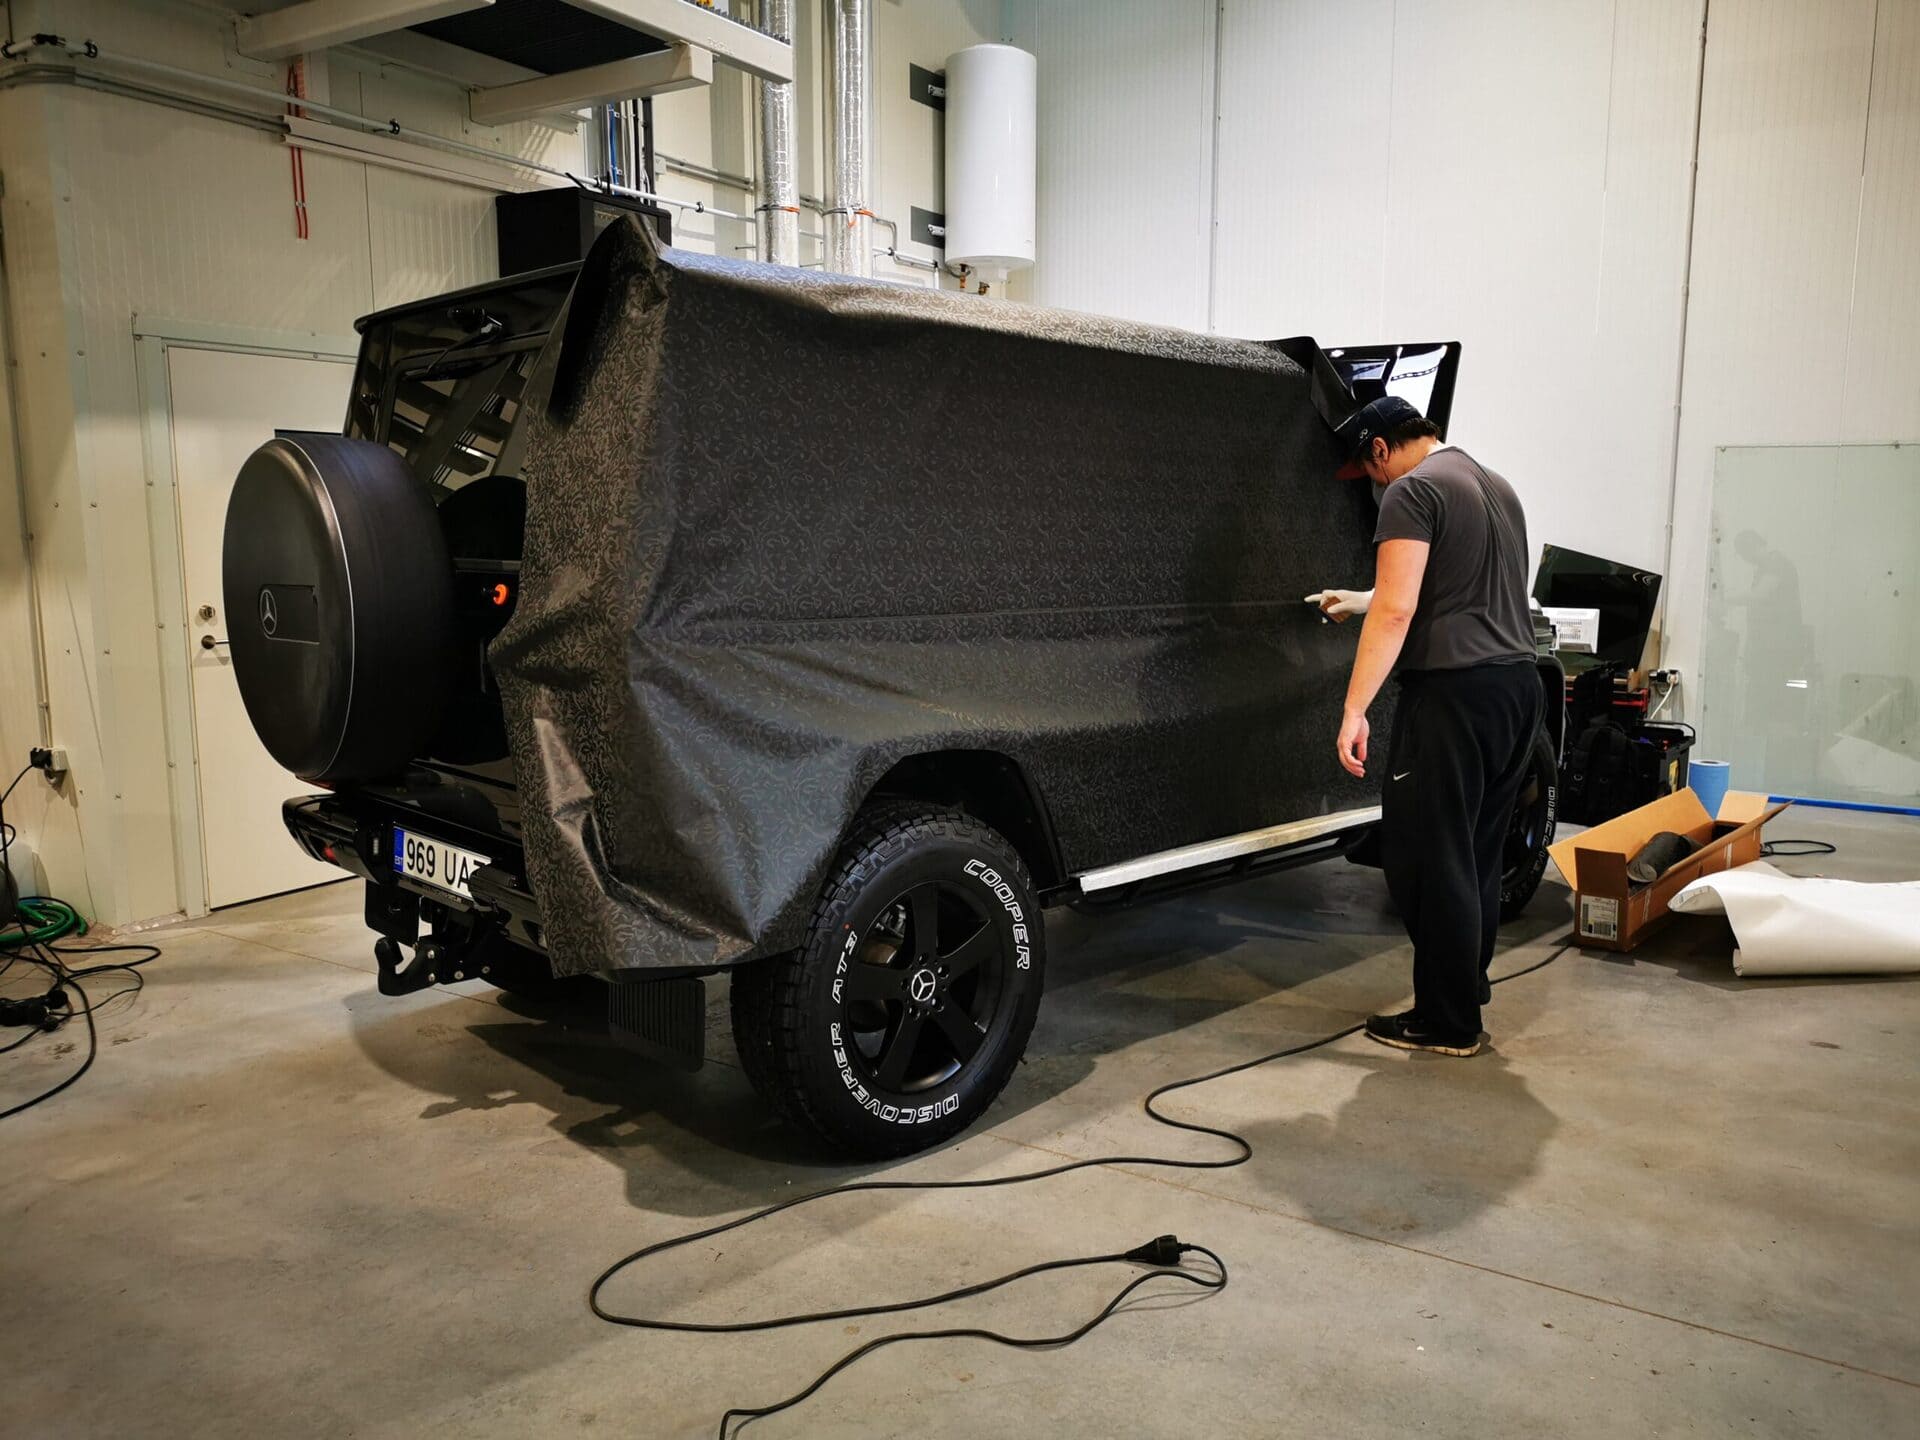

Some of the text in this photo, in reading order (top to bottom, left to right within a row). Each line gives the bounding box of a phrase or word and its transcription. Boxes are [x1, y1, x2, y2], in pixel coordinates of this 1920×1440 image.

[407, 838, 486, 888] 969 UA
[963, 859, 1030, 970] COOPER
[830, 1022, 959, 1124] DISCOVERER
